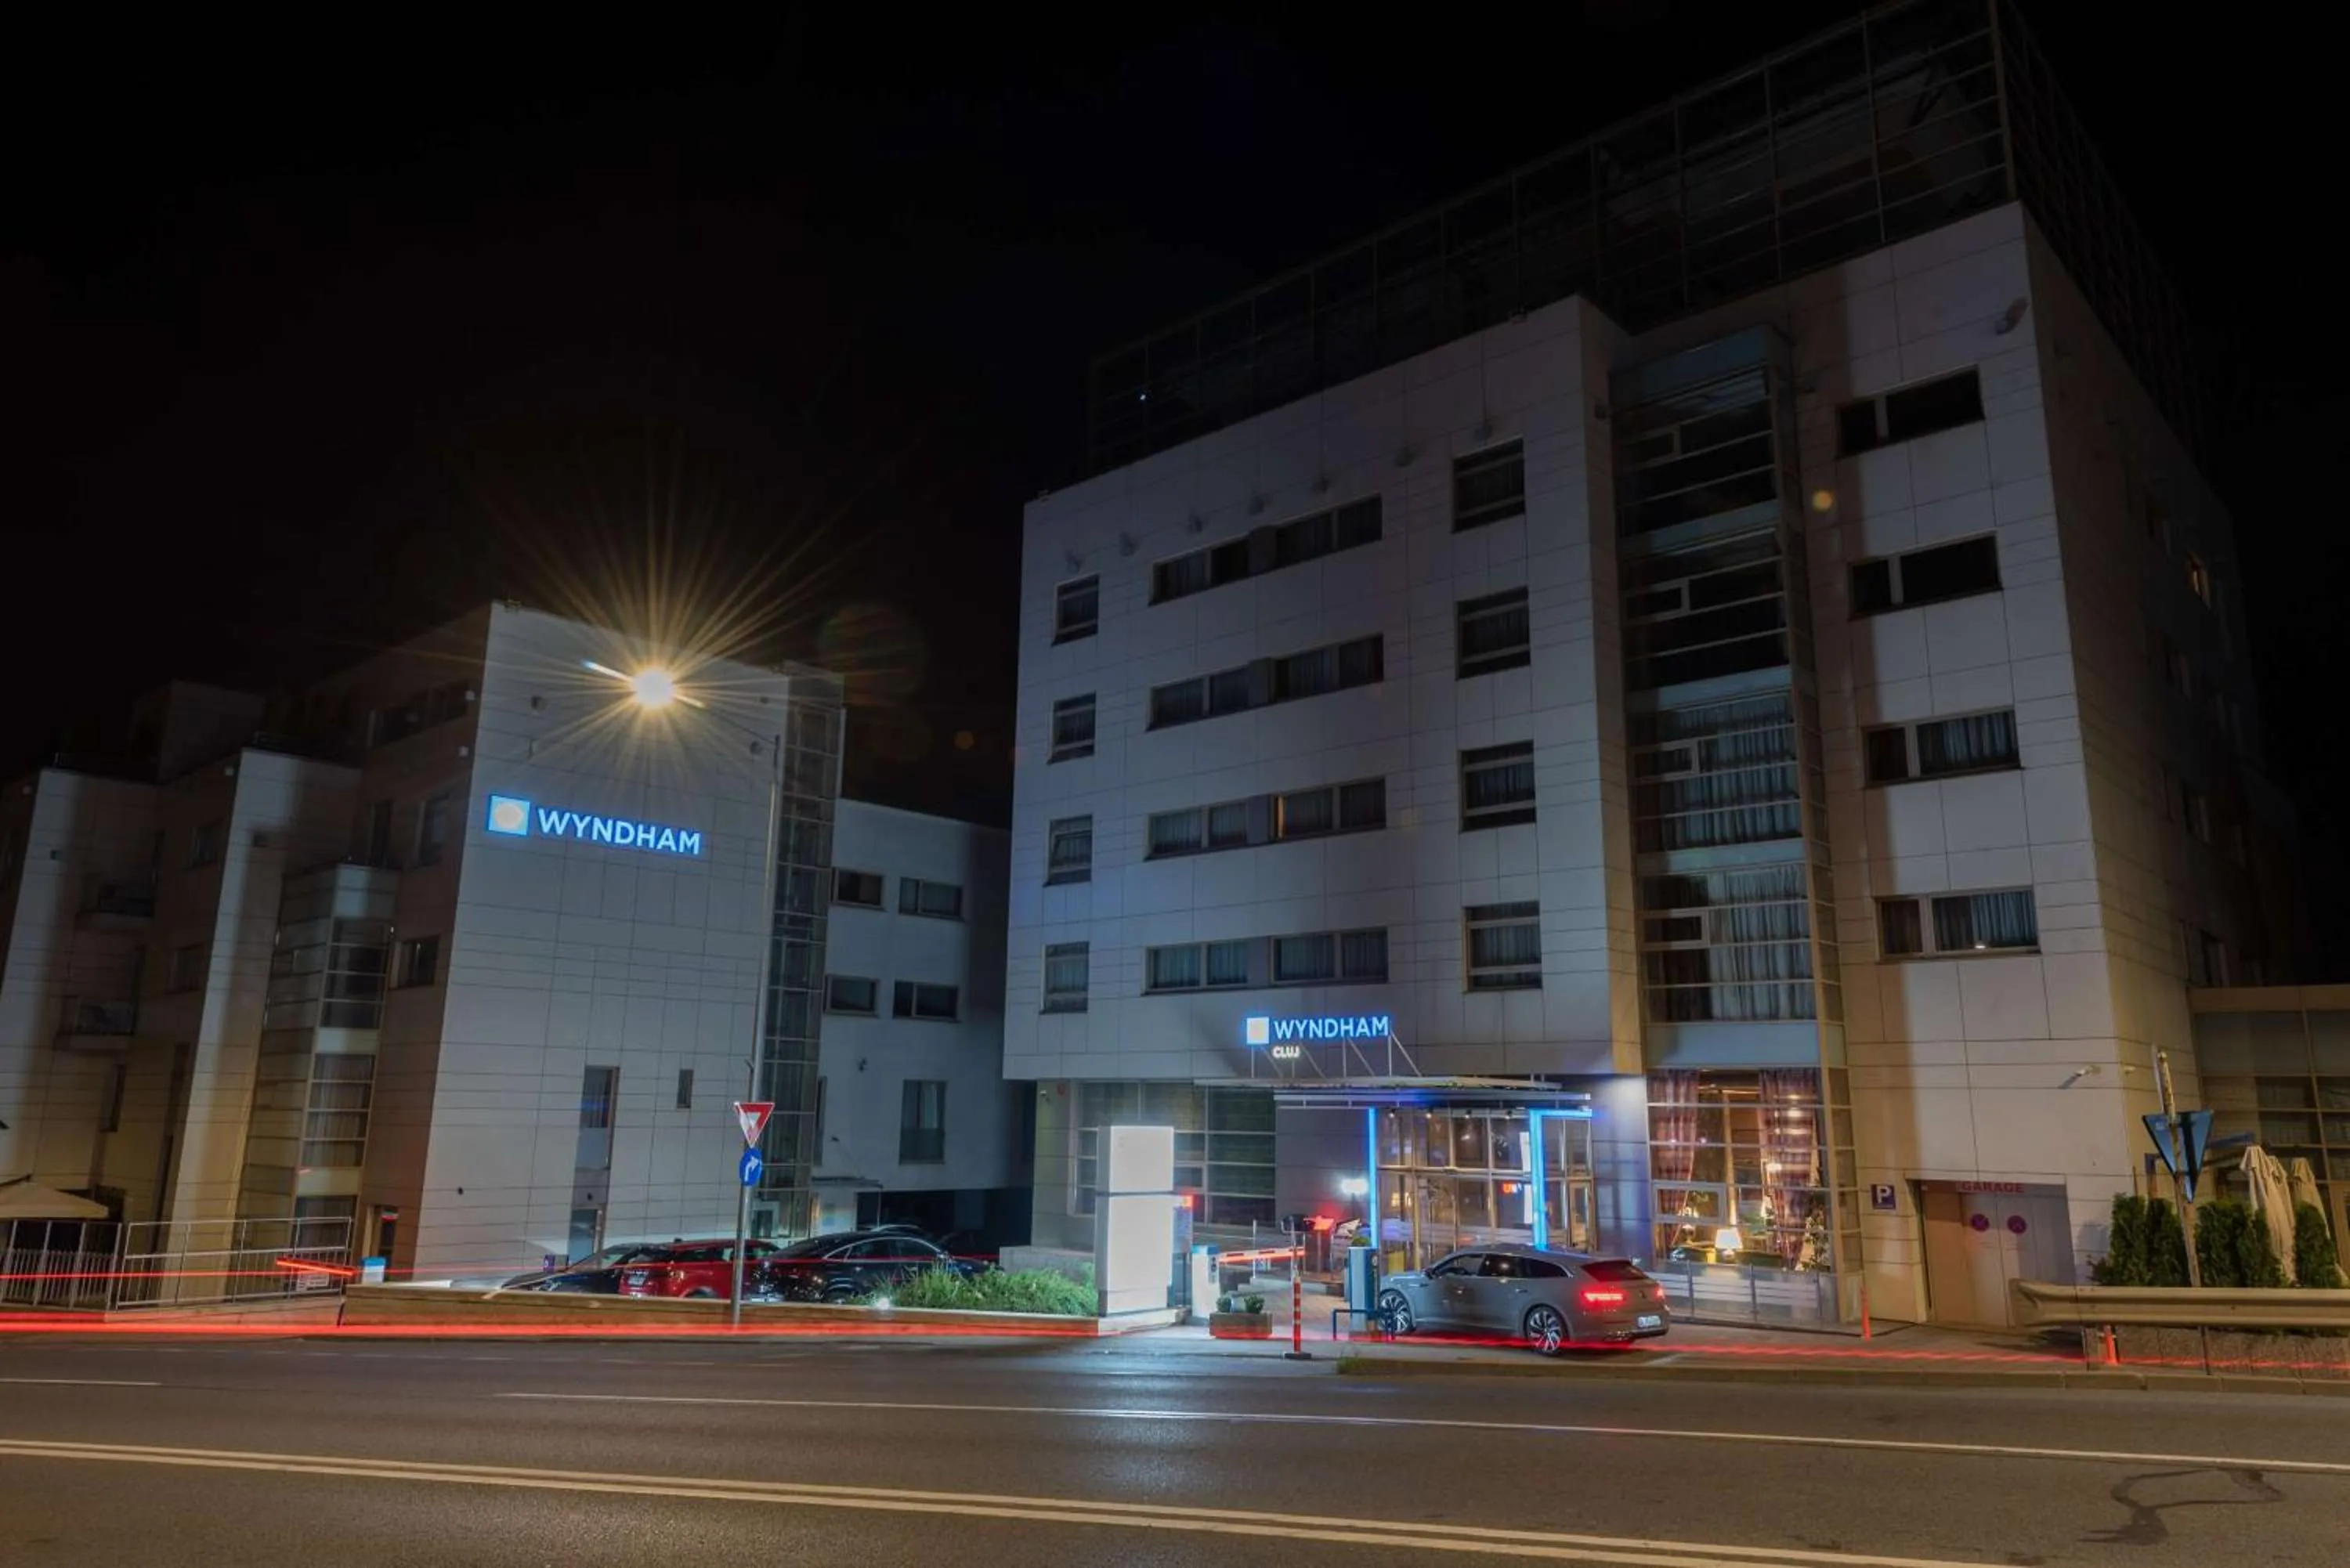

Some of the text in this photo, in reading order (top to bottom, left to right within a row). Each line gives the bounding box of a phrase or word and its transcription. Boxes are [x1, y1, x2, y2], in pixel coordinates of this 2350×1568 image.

[537, 807, 700, 855] WYNDHAM
[1274, 1016, 1389, 1040] WYNDHAM
[1272, 1046, 1300, 1058] CLUJ
[1876, 1185, 1893, 1204] P
[1961, 1181, 2025, 1194] GARAGE
